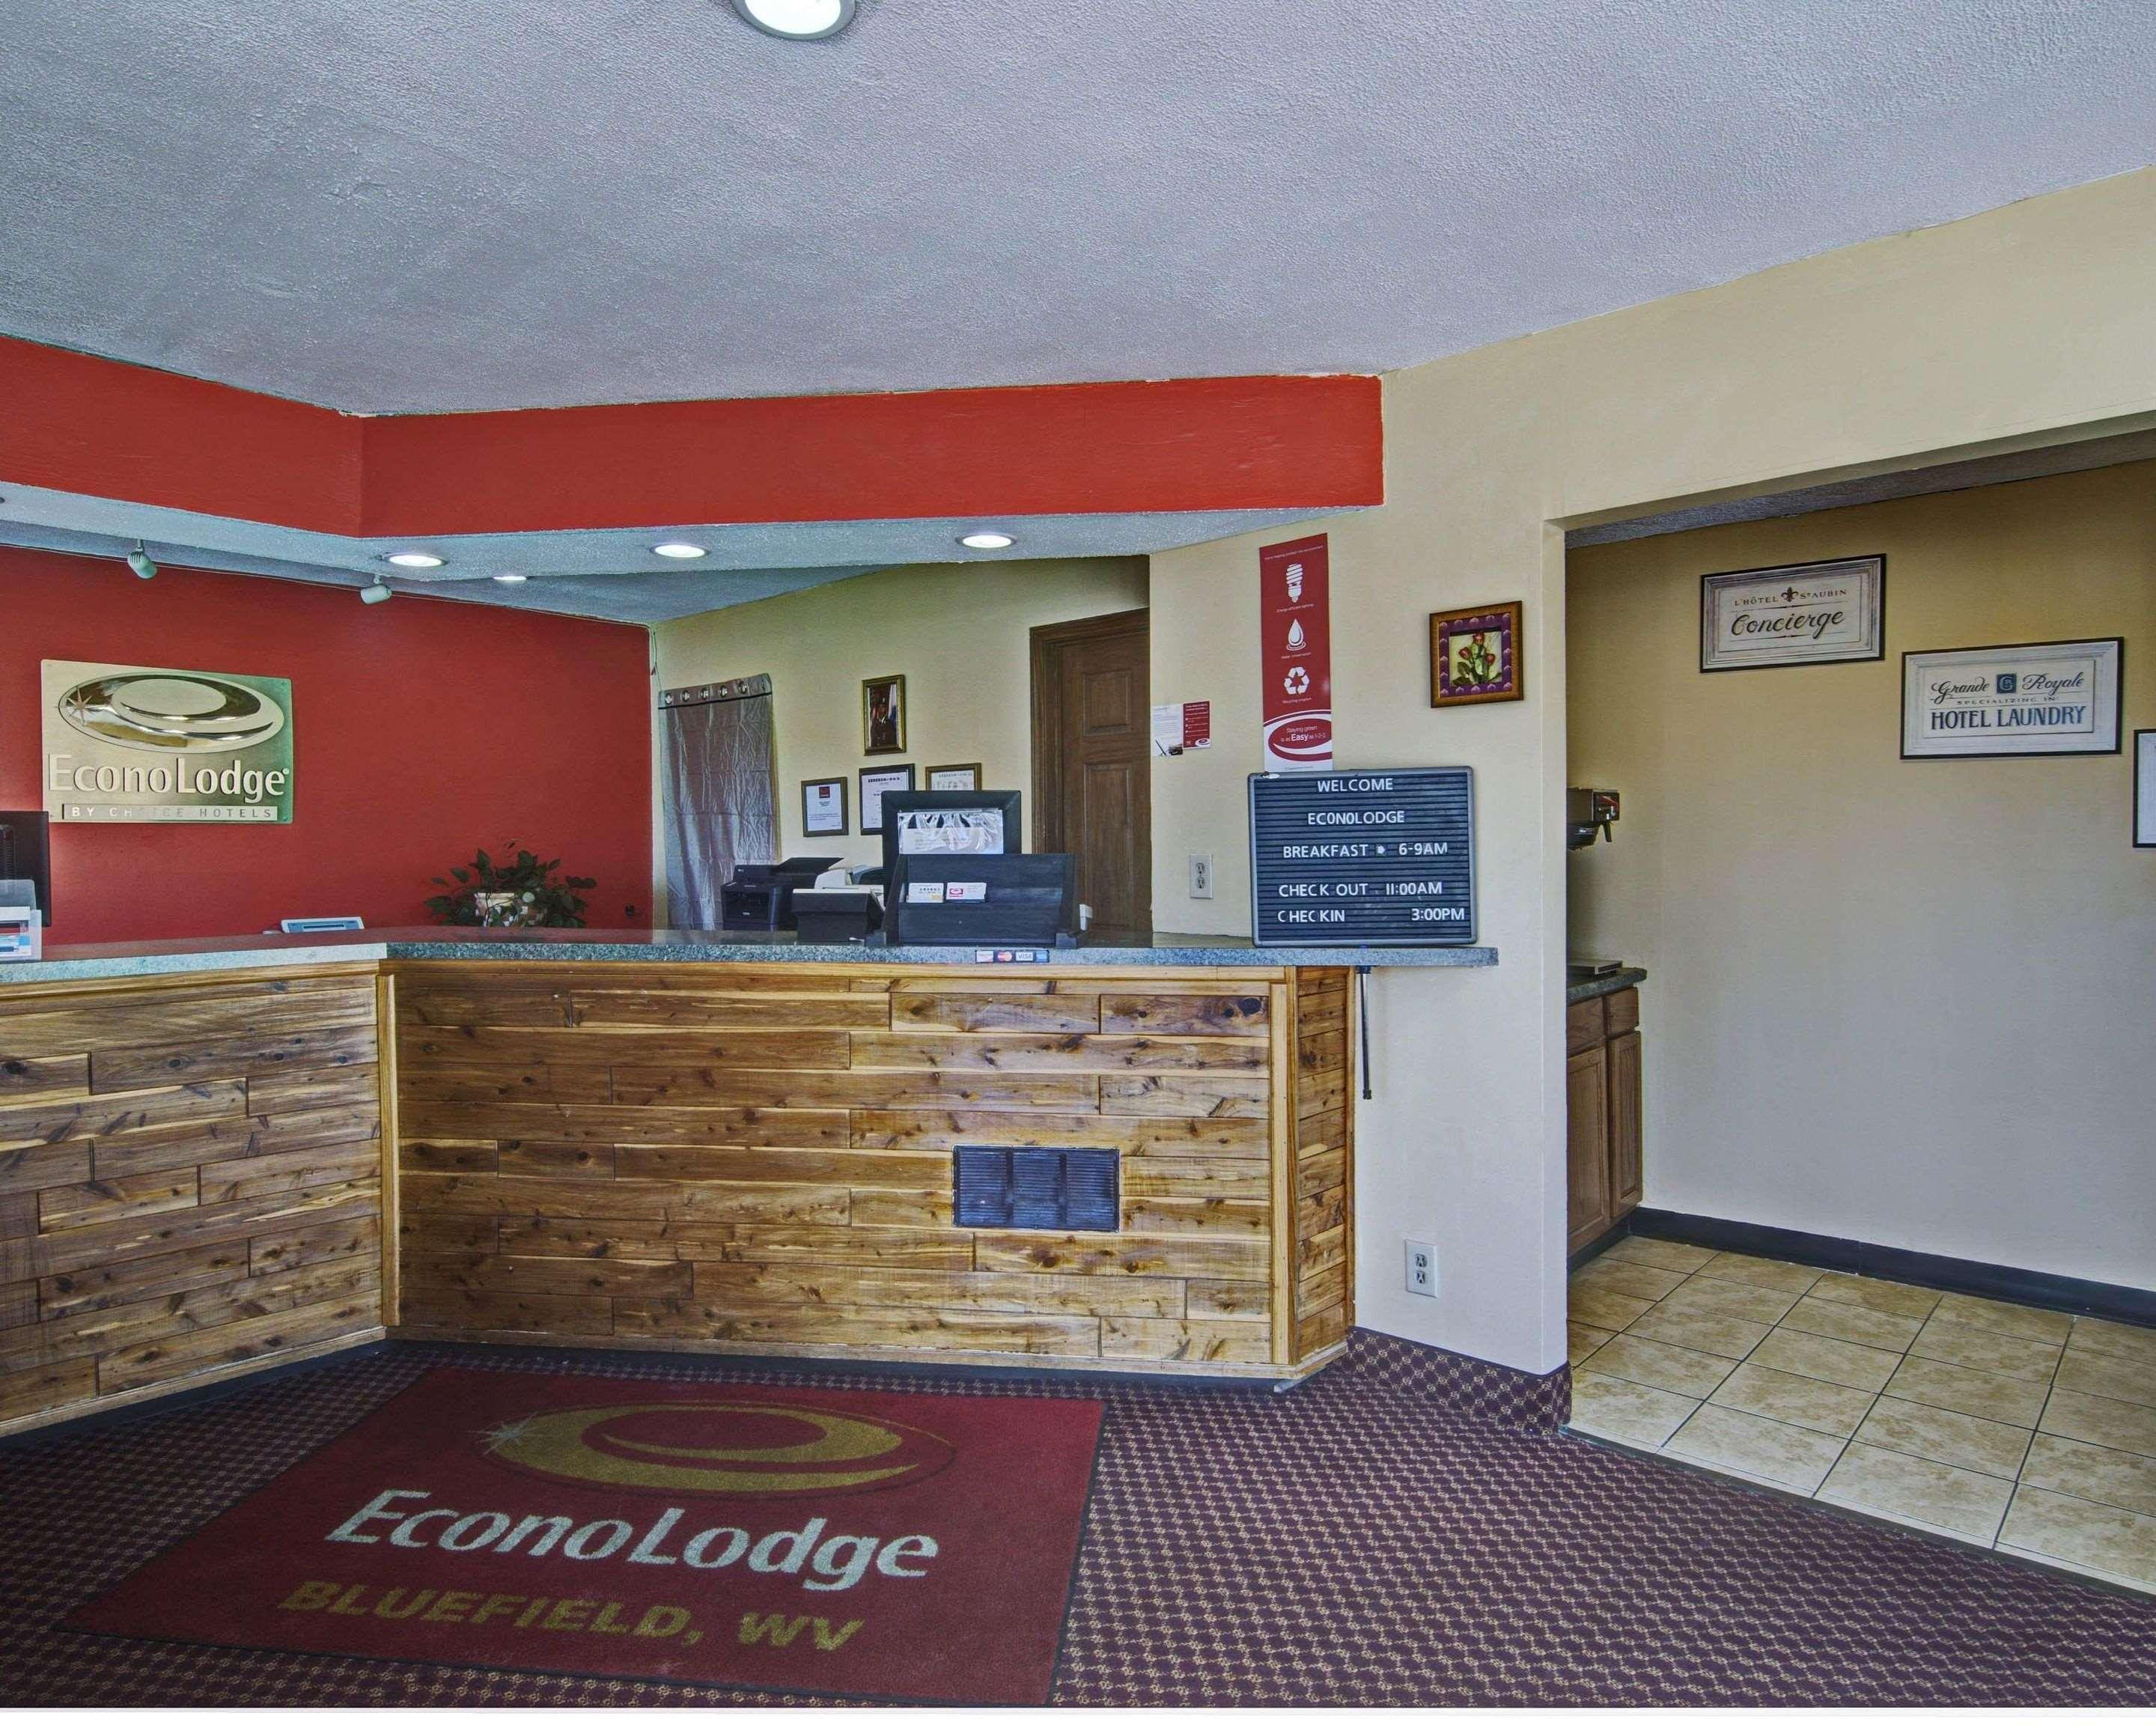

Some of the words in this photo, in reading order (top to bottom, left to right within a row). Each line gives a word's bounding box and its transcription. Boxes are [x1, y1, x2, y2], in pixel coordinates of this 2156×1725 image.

[1812, 589, 1847, 598] AUBIN
[1731, 610, 1845, 639] Concierge
[1930, 676, 1991, 705] Grande
[2022, 672, 2086, 696] Royale
[1956, 696, 2037, 705] SPECIALIZING
[1931, 710, 1991, 730] HOTEL
[1997, 706, 2086, 727] LAUNDRY
[1291, 733, 1309, 742] Easy
[48, 753, 287, 803] EconoLodge
[1317, 778, 1394, 792] WELCOME
[71, 806, 96, 818] BY
[199, 807, 272, 818] HOTELS
[1282, 844, 1369, 859] BREAKFAST
[1398, 842, 1449, 856] 6-9AM
[1278, 883, 1330, 897] CHECK
[1336, 883, 1368, 896] OUT
[1411, 907, 1465, 921] 3:00PM
[323, 1489, 940, 1592] EconoLodge
[278, 1580, 705, 1646] BLUEFIELD,
[737, 1610, 866, 1652] WV
